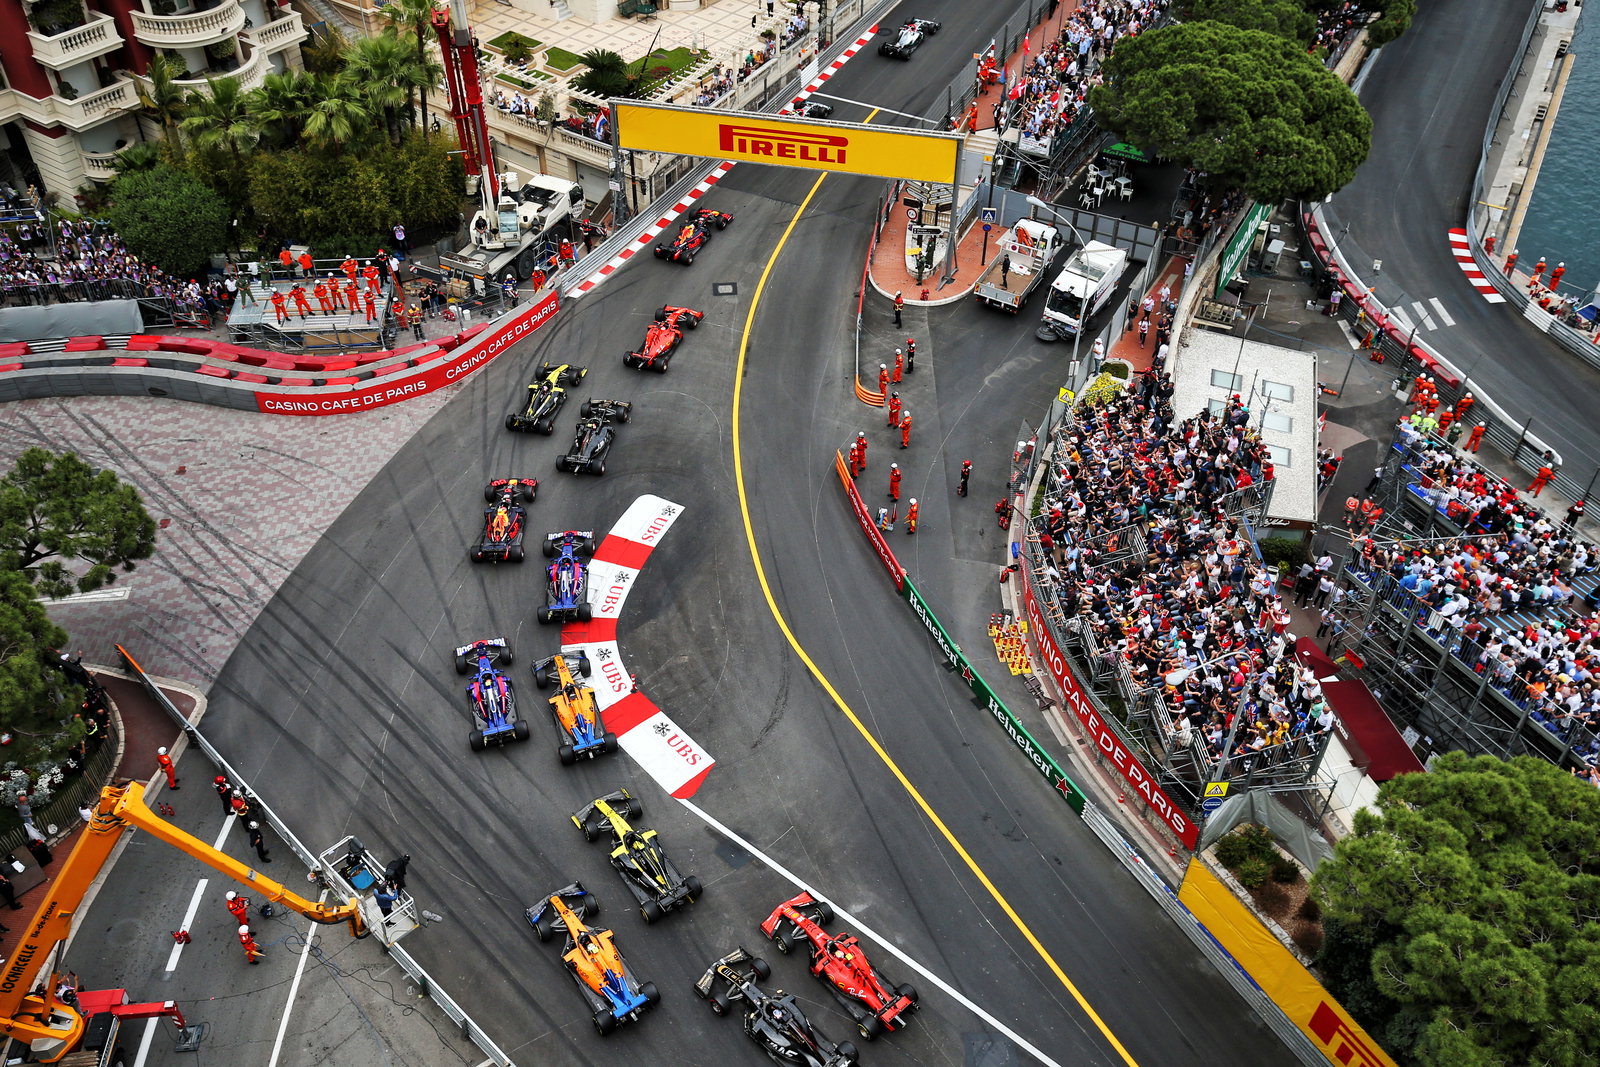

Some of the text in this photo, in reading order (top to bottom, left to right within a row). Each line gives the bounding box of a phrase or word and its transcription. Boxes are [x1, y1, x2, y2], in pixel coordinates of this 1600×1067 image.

[718, 123, 849, 165] PIRELLI
[446, 300, 557, 379] CASINO CAFE DE PARIS
[265, 380, 427, 412] CASINO CAFE DE PARIS
[641, 517, 668, 542] UBS
[601, 585, 624, 614] UBS
[908, 590, 958, 667] Heineken
[601, 661, 628, 693] UBS
[1029, 599, 1185, 834] CASINO CAFE DE PARIS
[667, 733, 702, 766] UBS
[988, 696, 1052, 777] Heineken
